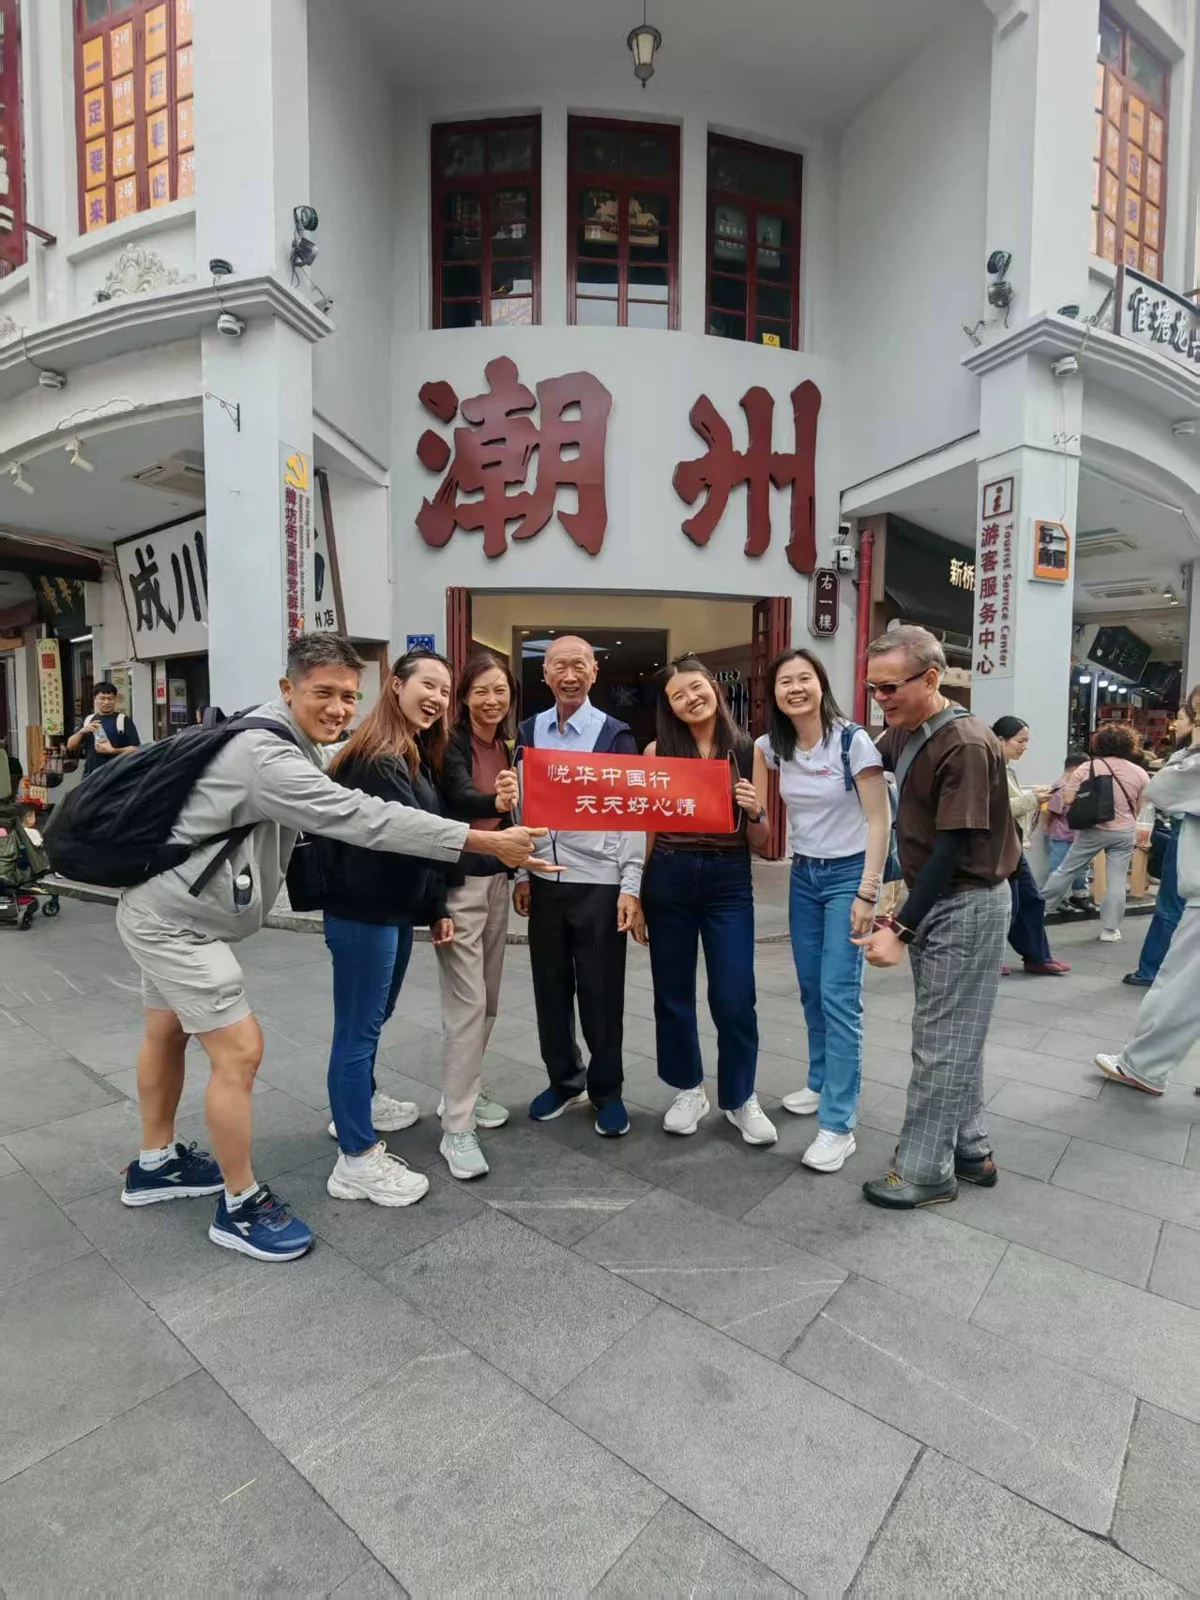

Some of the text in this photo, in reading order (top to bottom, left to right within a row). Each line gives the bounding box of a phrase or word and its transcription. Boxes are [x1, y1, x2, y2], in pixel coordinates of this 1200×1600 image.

[414, 355, 822, 574] 潮州
[977, 523, 999, 674] 游客服务中心
[1000, 522, 1013, 668] Tourist Service Center
[548, 764, 671, 789] 悦华中国行
[575, 795, 697, 817] 天天好心情
